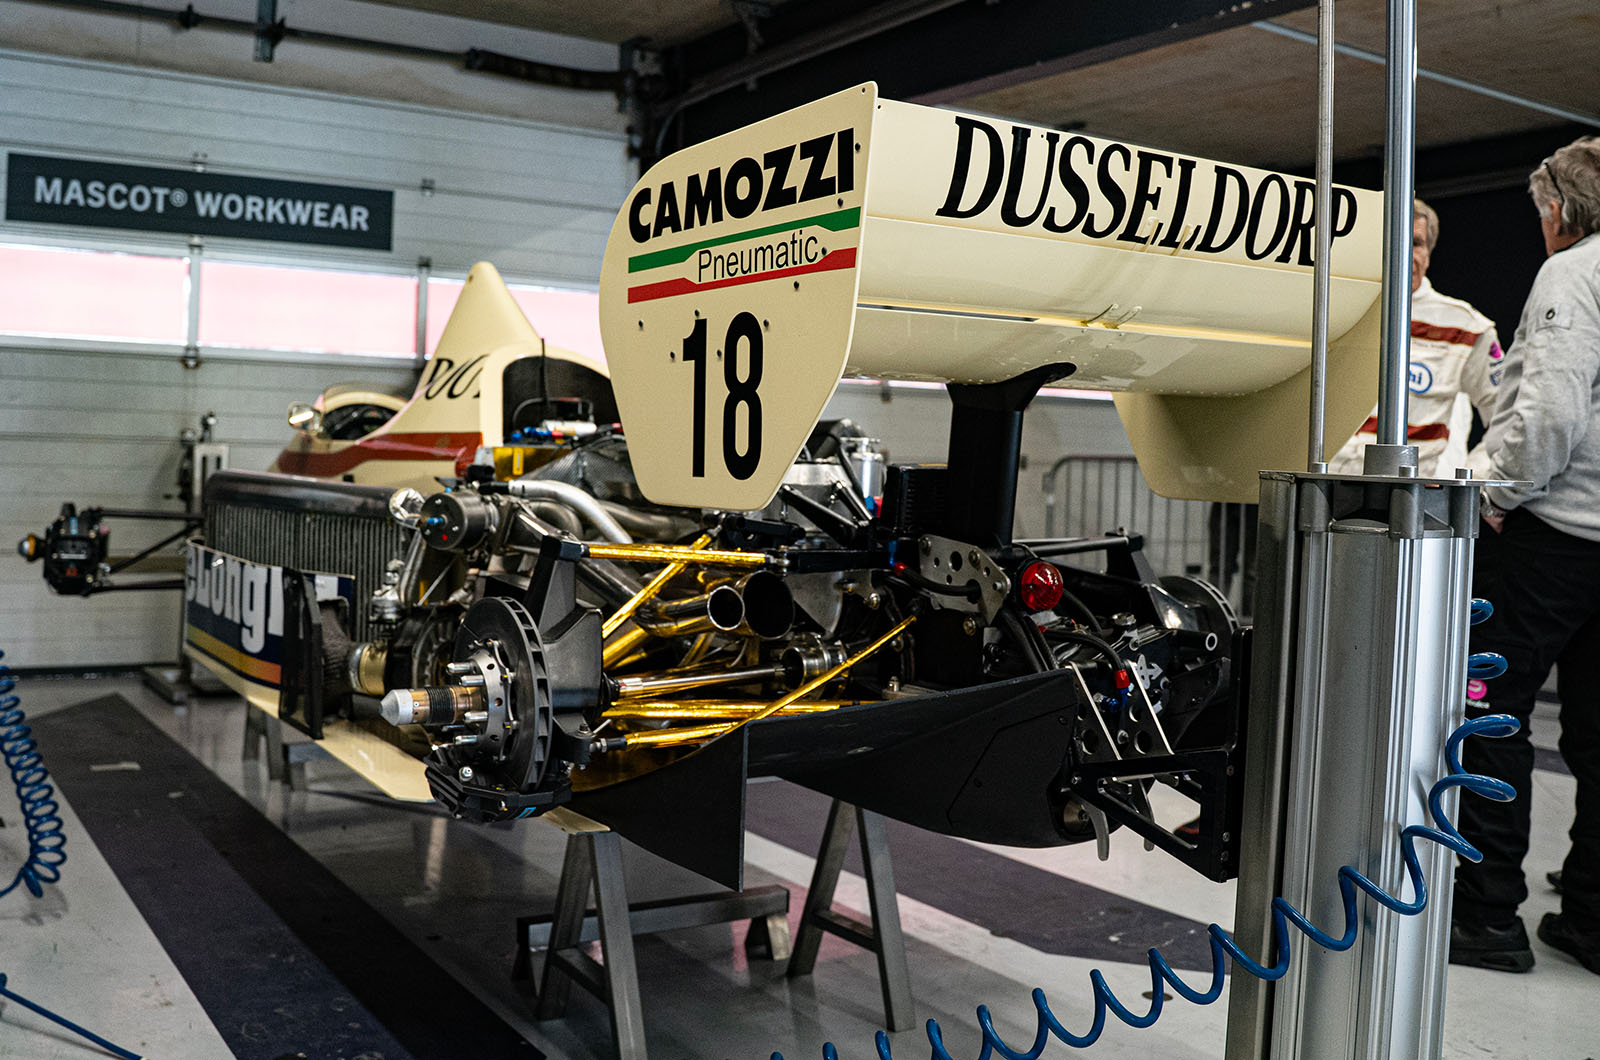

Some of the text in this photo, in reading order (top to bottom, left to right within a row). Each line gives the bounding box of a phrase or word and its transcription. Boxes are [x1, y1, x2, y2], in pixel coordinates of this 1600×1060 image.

[193, 190, 370, 232] WORKWEAR
[628, 127, 855, 244] CAMOZZI
[935, 115, 1358, 267] DUSSELDORP
[698, 229, 819, 283] Pneumatic
[682, 311, 764, 480] 18
